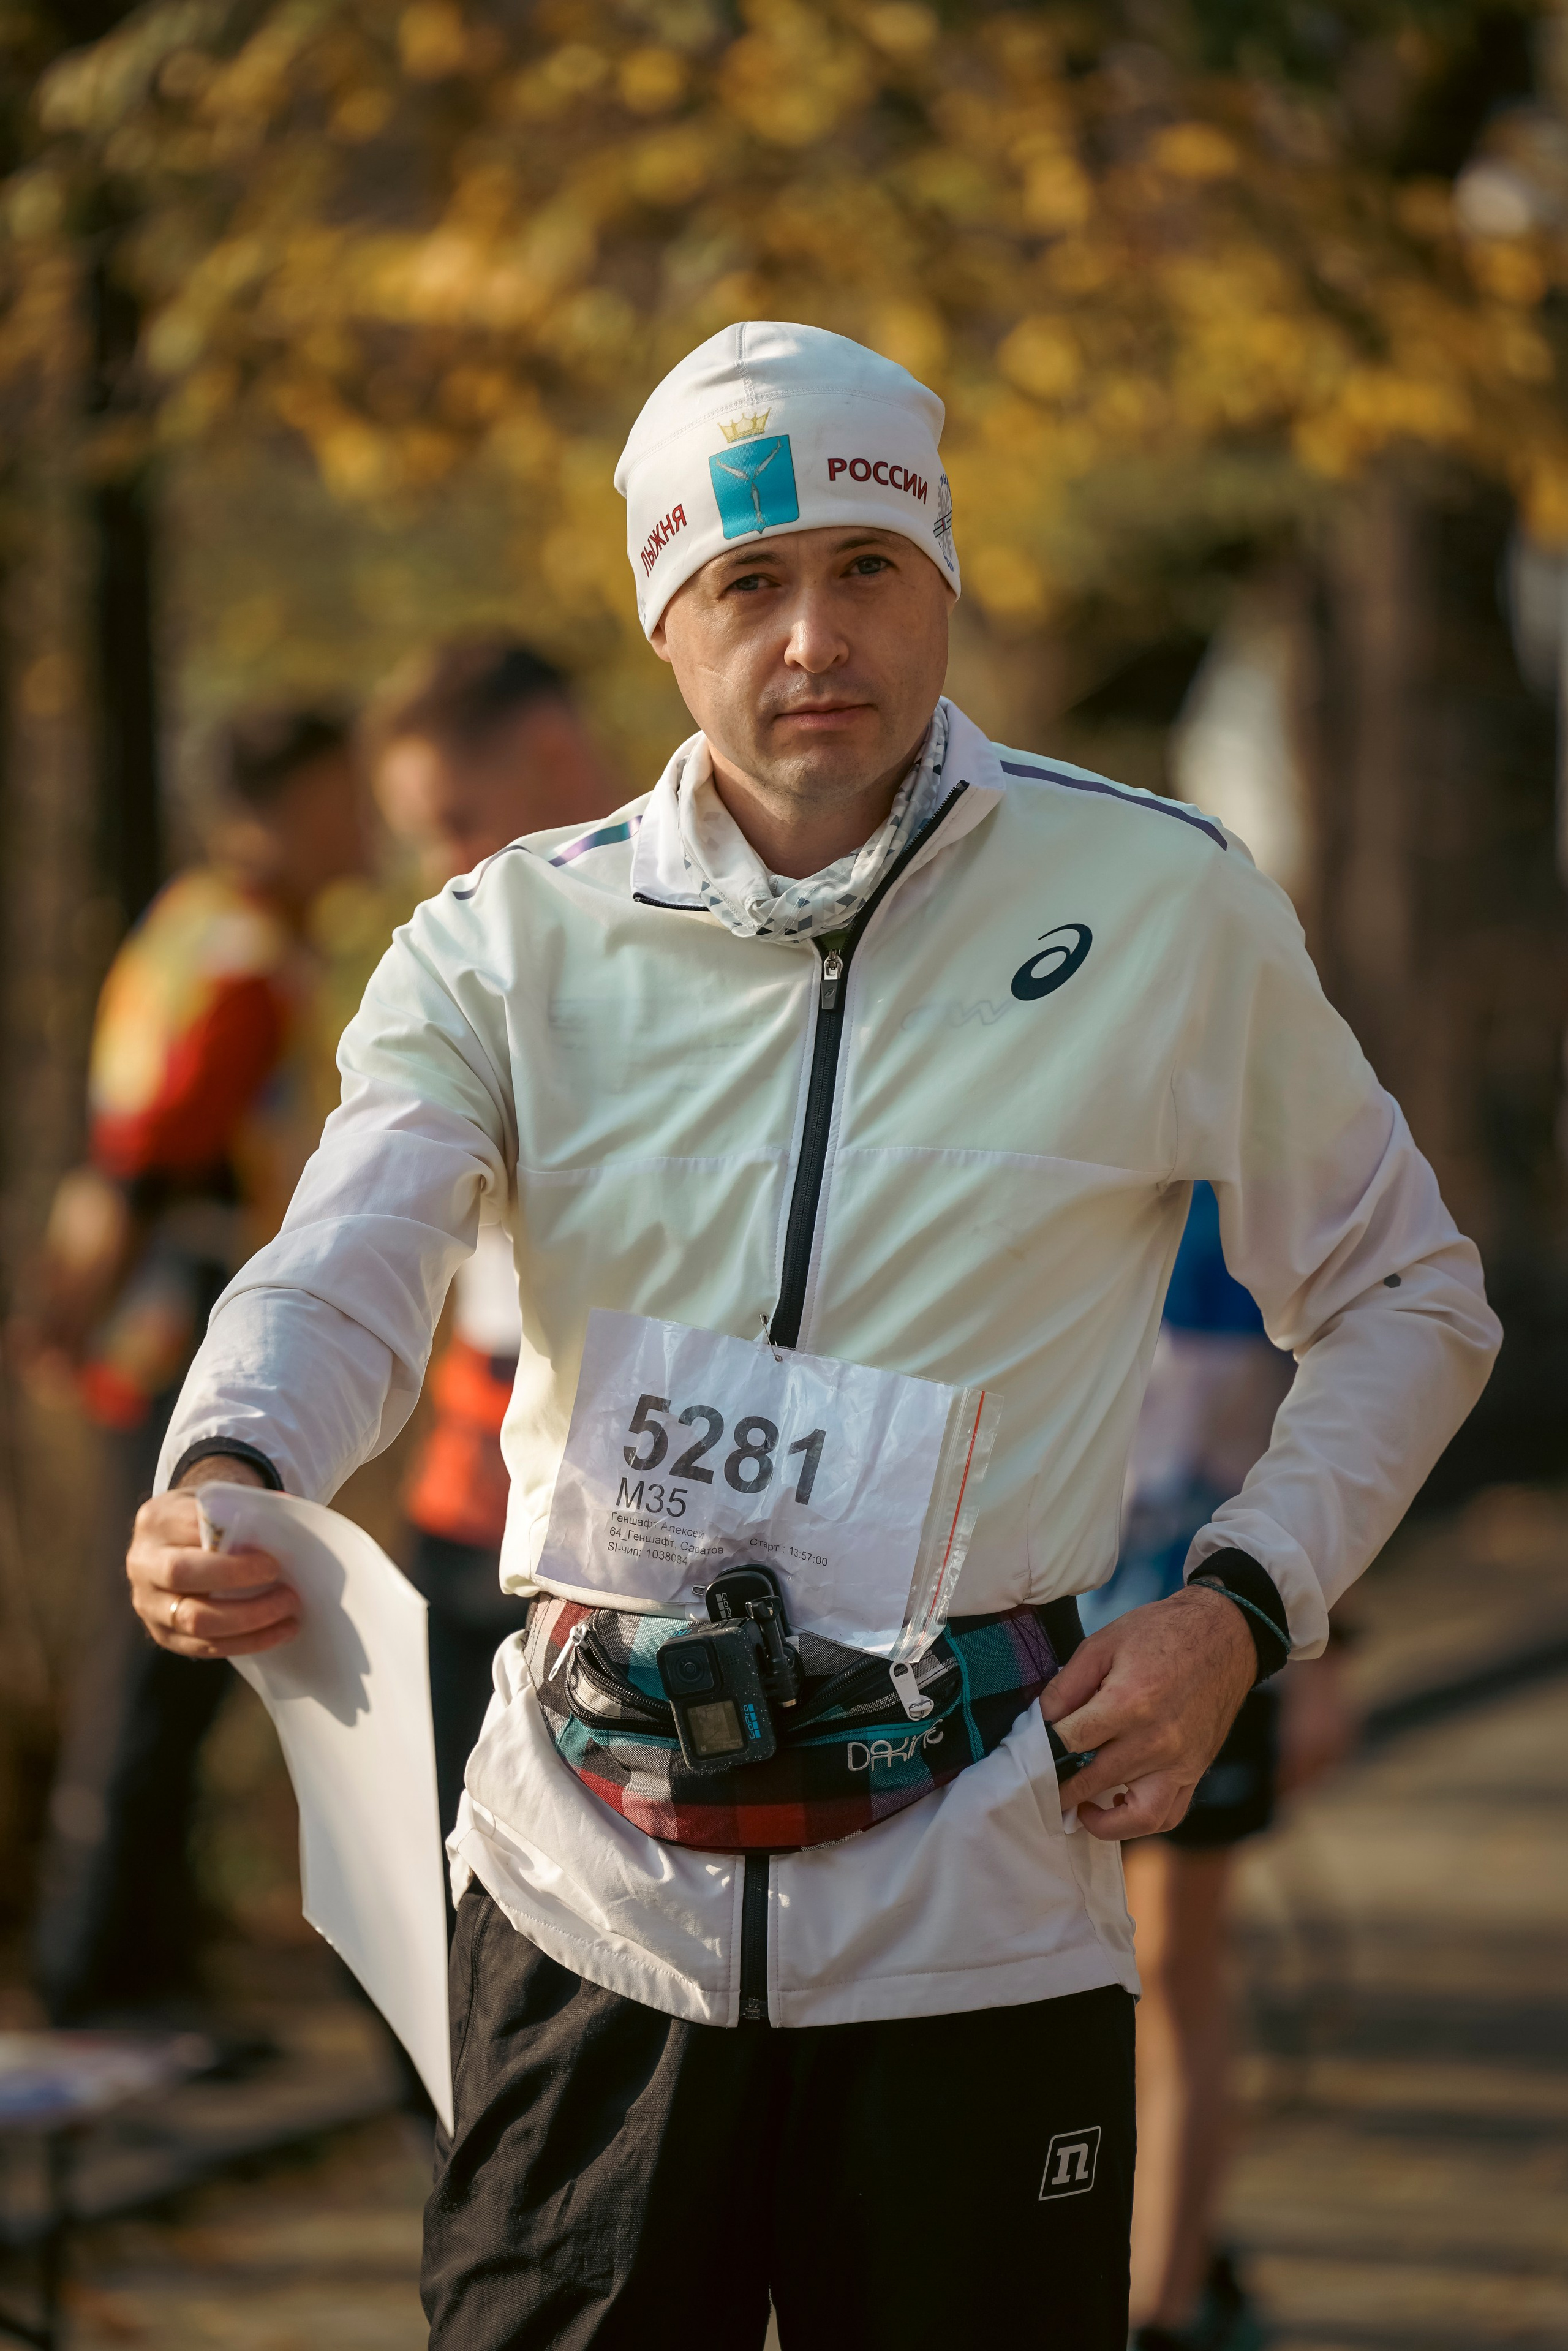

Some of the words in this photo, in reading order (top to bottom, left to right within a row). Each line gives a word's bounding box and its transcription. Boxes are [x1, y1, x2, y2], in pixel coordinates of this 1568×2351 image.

[640, 503, 687, 578] ЛЫЖНЯ
[827, 458, 928, 505] РОССИИ
[623, 1393, 827, 1506] 5281
[611, 1512, 657, 1529] Геншафт
[660, 1522, 704, 1539] Алексей
[608, 1542, 641, 1557] SI-чип:
[646, 1549, 688, 1565] 1038084
[680, 1541, 724, 1557] Саратов
[750, 1538, 780, 1552] Старт
[790, 1546, 828, 1566] 13:57:00
[743, 1705, 755, 1740] GoPro
